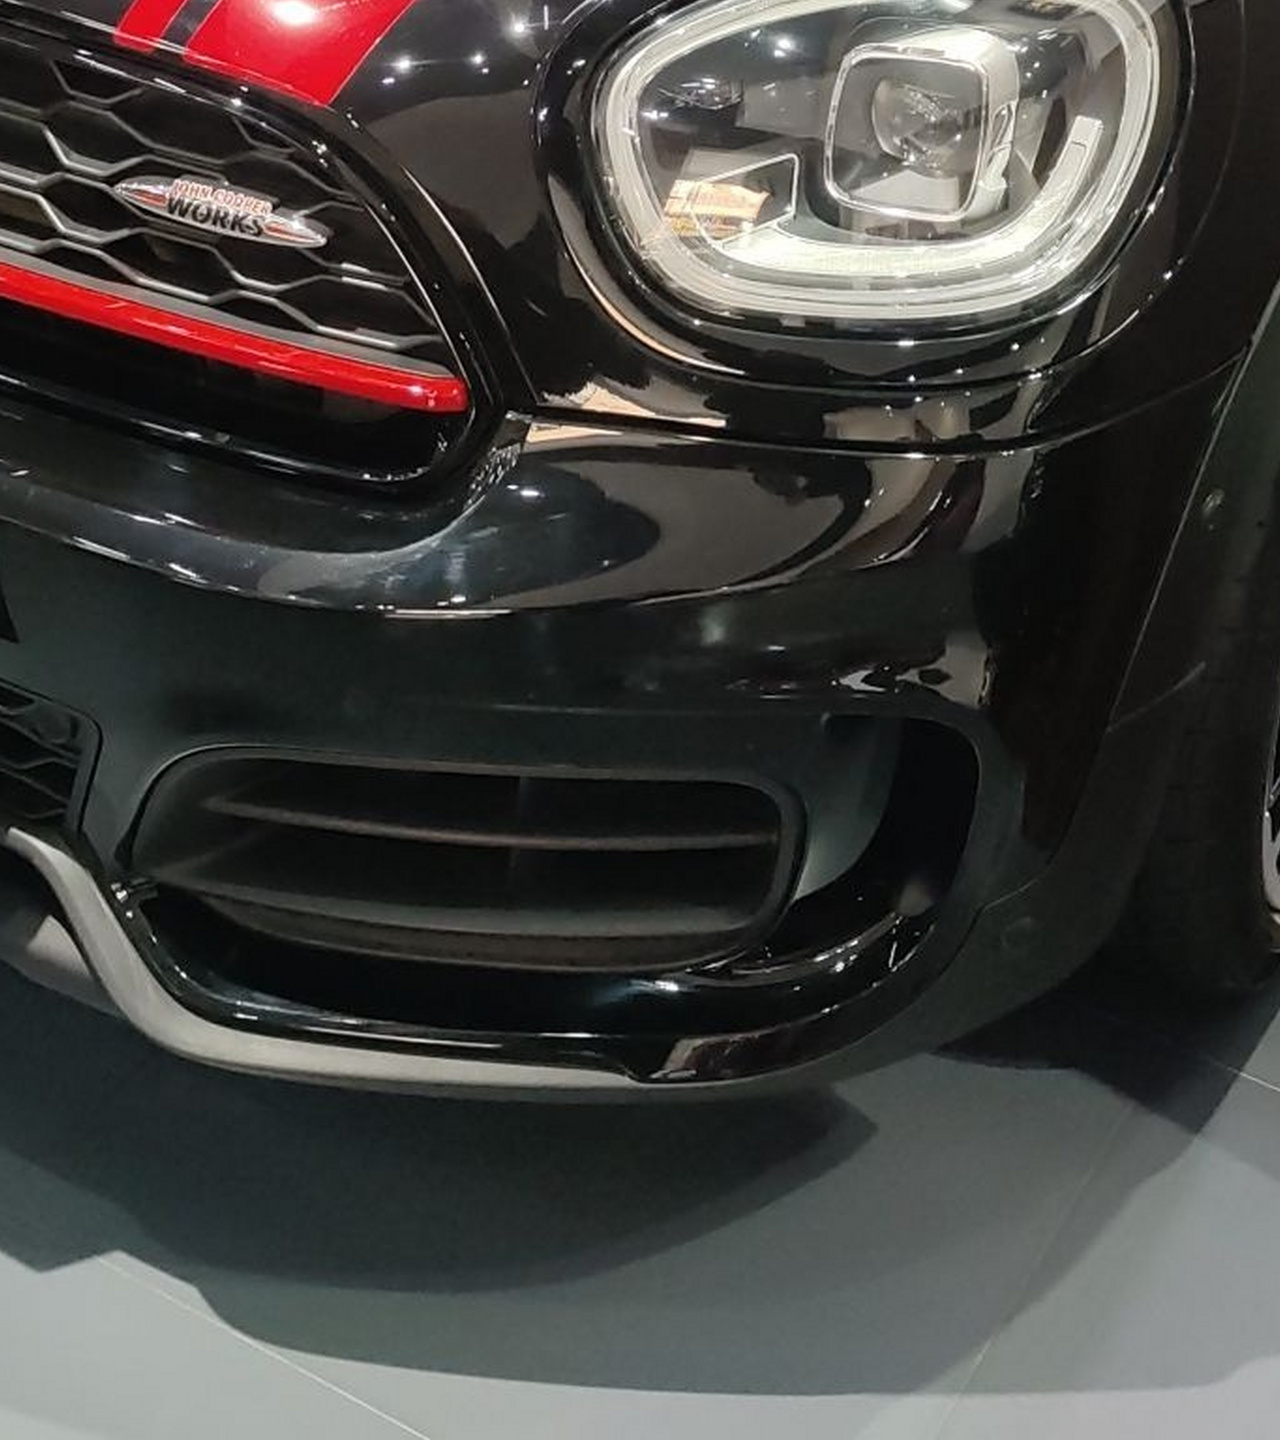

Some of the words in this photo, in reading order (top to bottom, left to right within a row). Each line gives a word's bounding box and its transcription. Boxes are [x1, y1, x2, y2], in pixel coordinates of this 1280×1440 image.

[172, 178, 212, 199] JOHN
[212, 188, 273, 216] COOPER
[167, 197, 264, 237] WORKS
